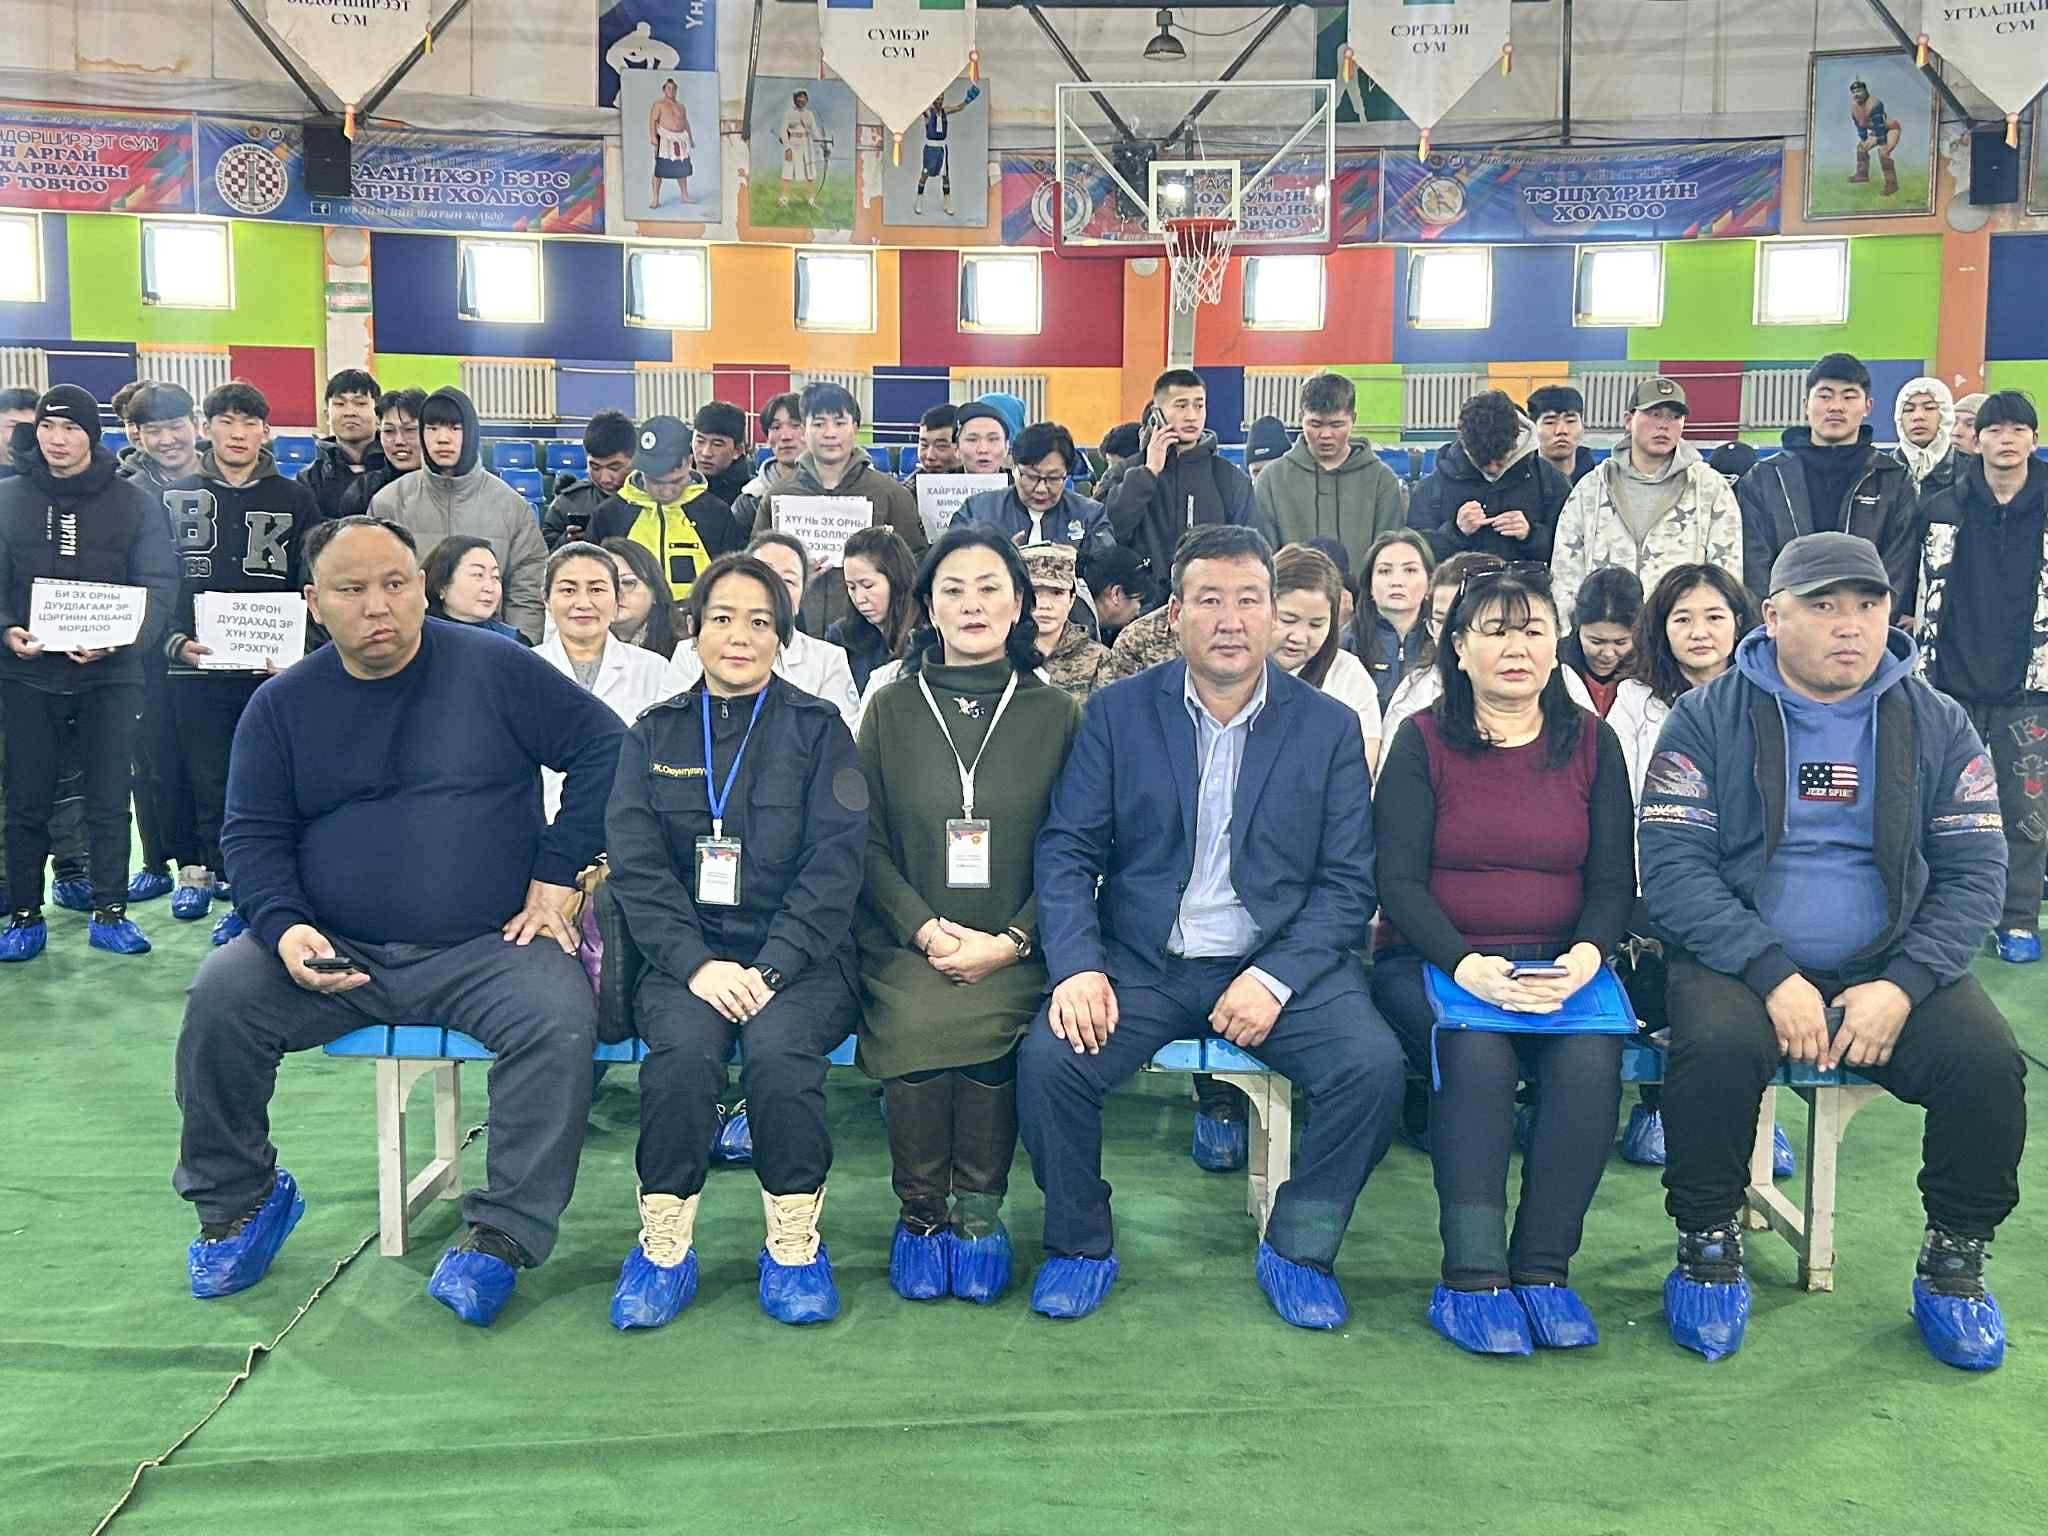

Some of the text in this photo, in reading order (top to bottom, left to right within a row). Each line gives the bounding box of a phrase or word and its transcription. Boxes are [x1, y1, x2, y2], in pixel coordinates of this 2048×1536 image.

[331, 12, 367, 27] СУМ
[1996, 19, 2035, 34] СУМ
[868, 28, 930, 41] СҮМБЭР
[1391, 23, 1469, 36] СЭРГЭЛЭН
[882, 46, 915, 59] СУМ
[1412, 41, 1446, 54] СУМ
[120, 136, 159, 151] СУМ
[24, 147, 97, 162] АРГАН
[0, 160, 128, 178] ХАРВААНЫ
[18, 177, 108, 192] ТОВЧОО
[422, 167, 496, 187] ИХЭР
[501, 170, 570, 190] БЭРС
[448, 186, 561, 208] ХОЛБОО
[1525, 181, 1697, 204] ТЭШҮҮРИЙН
[1554, 203, 1665, 222] ХОЛБОО
[785, 514, 801, 524] ХҮҮ
[821, 516, 835, 527] ЭХ
[837, 518, 867, 528] ОРНЫ
[243, 511, 292, 579] K
[55, 590, 120, 600] БИ ЭХ ОРНЫ
[43, 601, 129, 611] ДУУДЛАГААР ЭР
[232, 602, 281, 614] ЭХ ОРОН
[90, 613, 132, 621] АЛБАНД
[217, 614, 294, 629] ДУУДАХАД ЭР
[58, 624, 111, 633] МОРДЛОО
[225, 628, 284, 641] ХҮН УХРАХ
[229, 642, 279, 655] ЭРЭХГҮЙ
